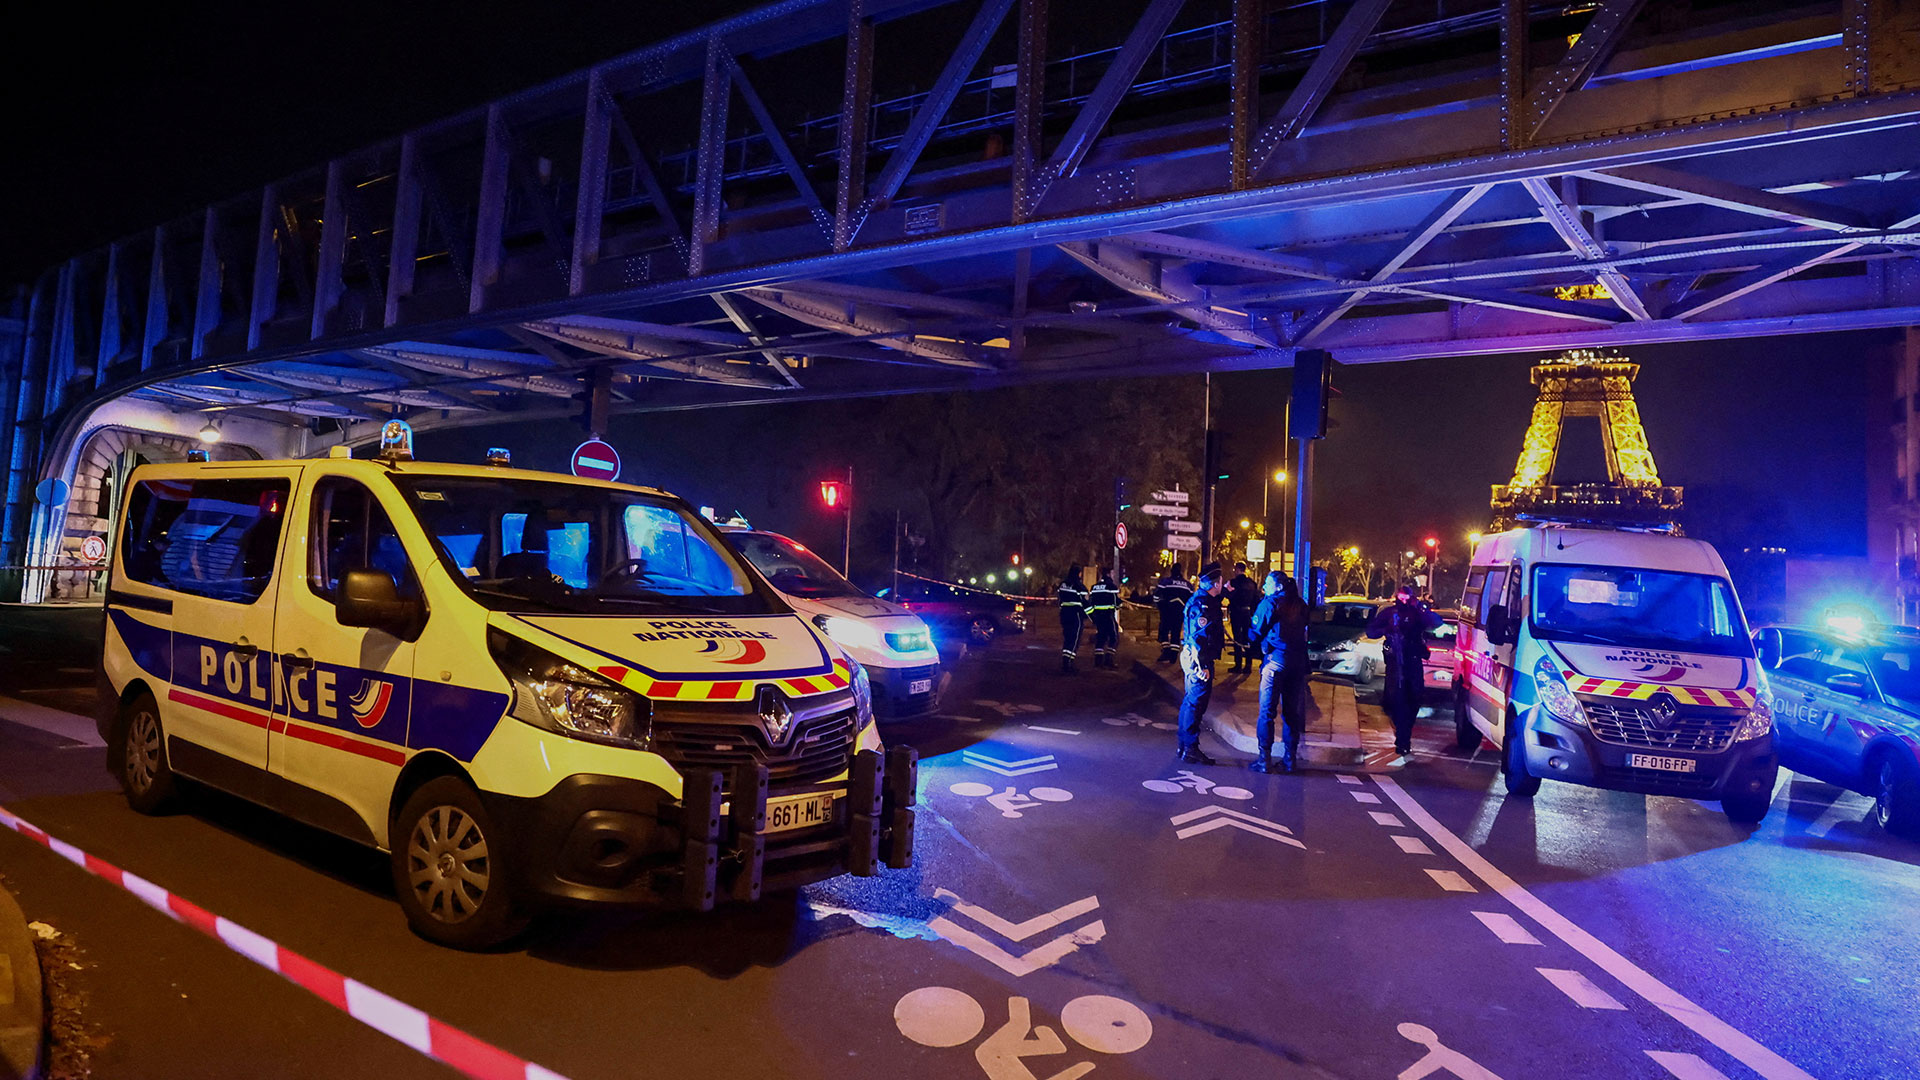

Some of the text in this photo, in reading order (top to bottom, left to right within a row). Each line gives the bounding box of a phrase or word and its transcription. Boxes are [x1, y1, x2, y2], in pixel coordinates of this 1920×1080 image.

[648, 621, 737, 630] POLICE
[632, 630, 778, 642] NATIONALE
[1605, 655, 1704, 669] NATIONALE
[1621, 650, 1681, 660] POLICE
[200, 645, 338, 720] POLICE
[1774, 698, 1819, 725] OLICE
[1634, 755, 1688, 771] FF-016-FP
[767, 800, 822, 828] -661-ML
